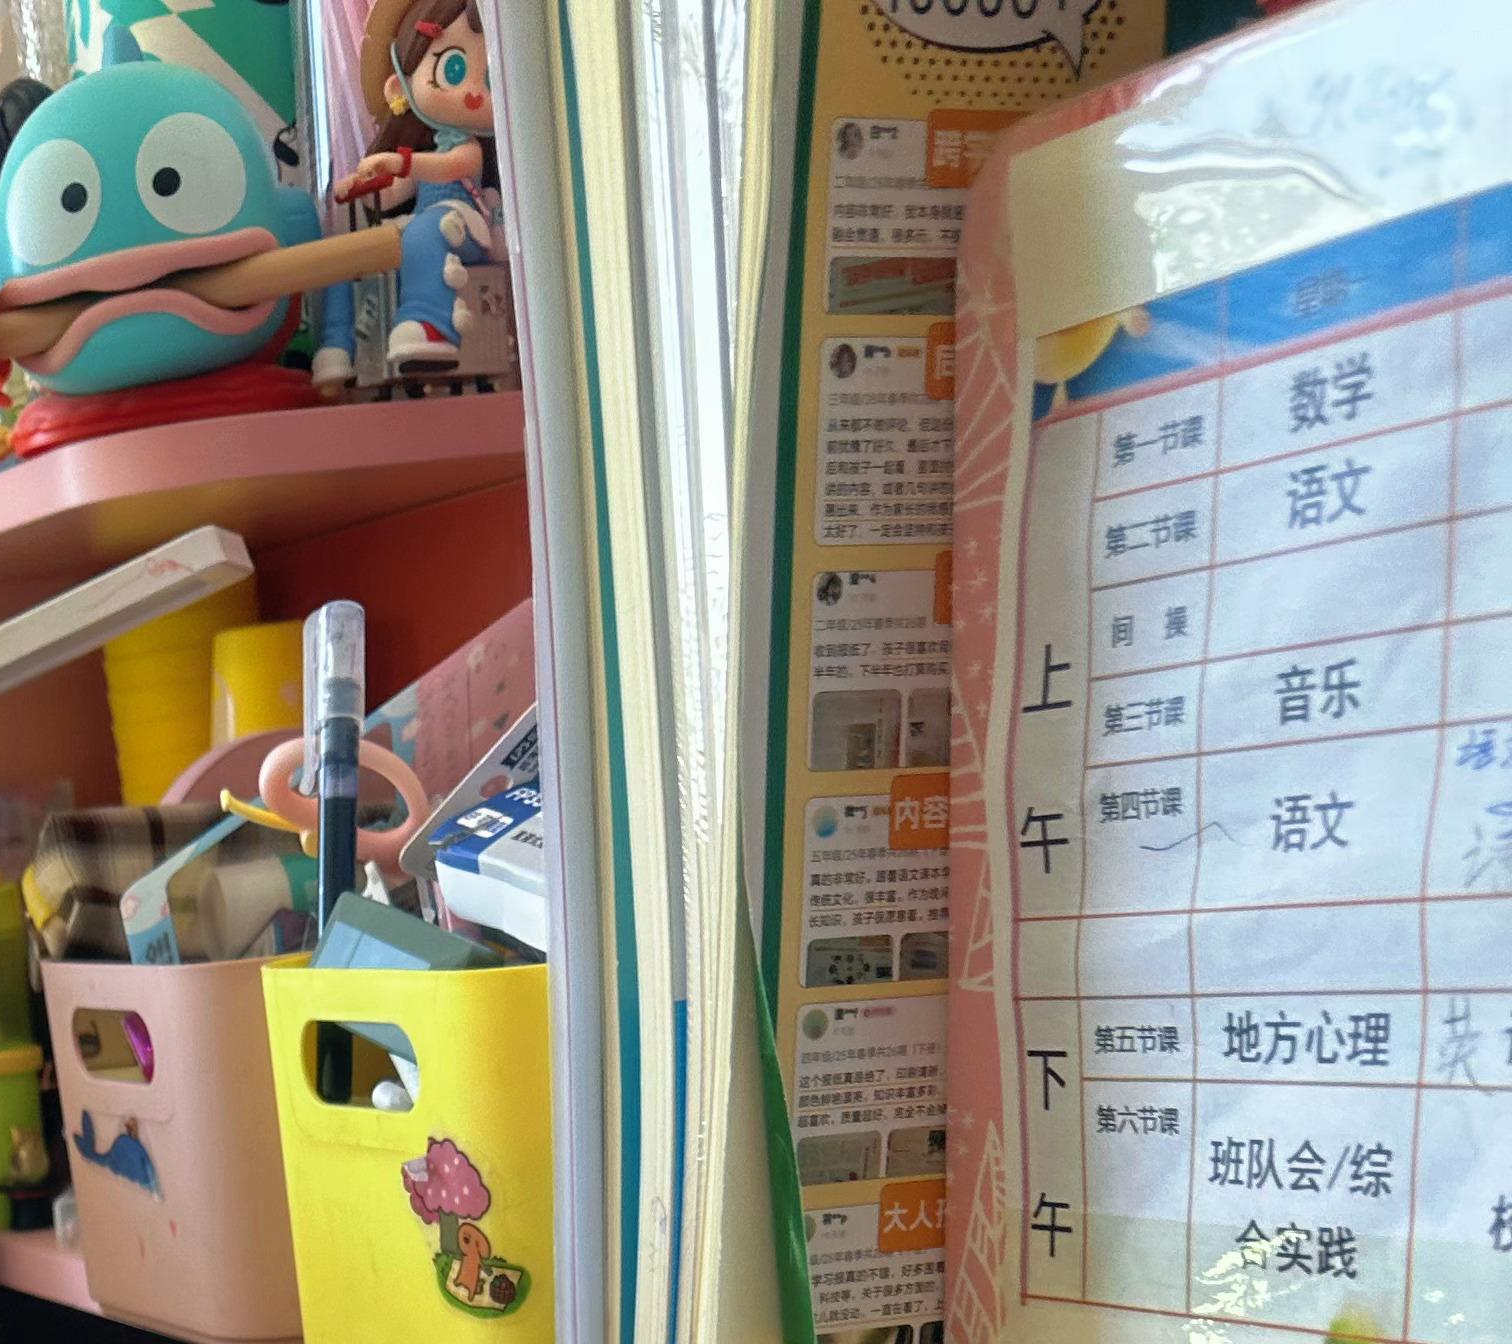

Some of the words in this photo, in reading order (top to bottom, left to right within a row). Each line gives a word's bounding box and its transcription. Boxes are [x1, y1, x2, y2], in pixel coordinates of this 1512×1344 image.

[1290, 352, 1375, 433] 数学
[1112, 425, 1204, 467] 第一节课
[1286, 458, 1372, 530] 语文
[1105, 512, 1199, 560] 第二节课
[1111, 613, 1135, 649] 间
[1164, 604, 1190, 640] 操
[1021, 643, 1072, 716] 上
[1273, 657, 1362, 727] 音乐
[1103, 690, 1186, 736] 第三节课
[894, 795, 949, 832] 内容
[1099, 786, 1185, 825] 第四节课
[1269, 794, 1356, 854] 语文
[1020, 807, 1071, 875] 午
[1094, 1024, 1180, 1057] 第五节课
[1223, 1013, 1392, 1068] 地方心理
[1027, 1049, 1068, 1115] 下
[1096, 1105, 1180, 1138] 第六节课
[1208, 1137, 1395, 1198] 班队会/综
[1030, 1195, 1074, 1260] 午
[1235, 1221, 1360, 1280] 合实践
